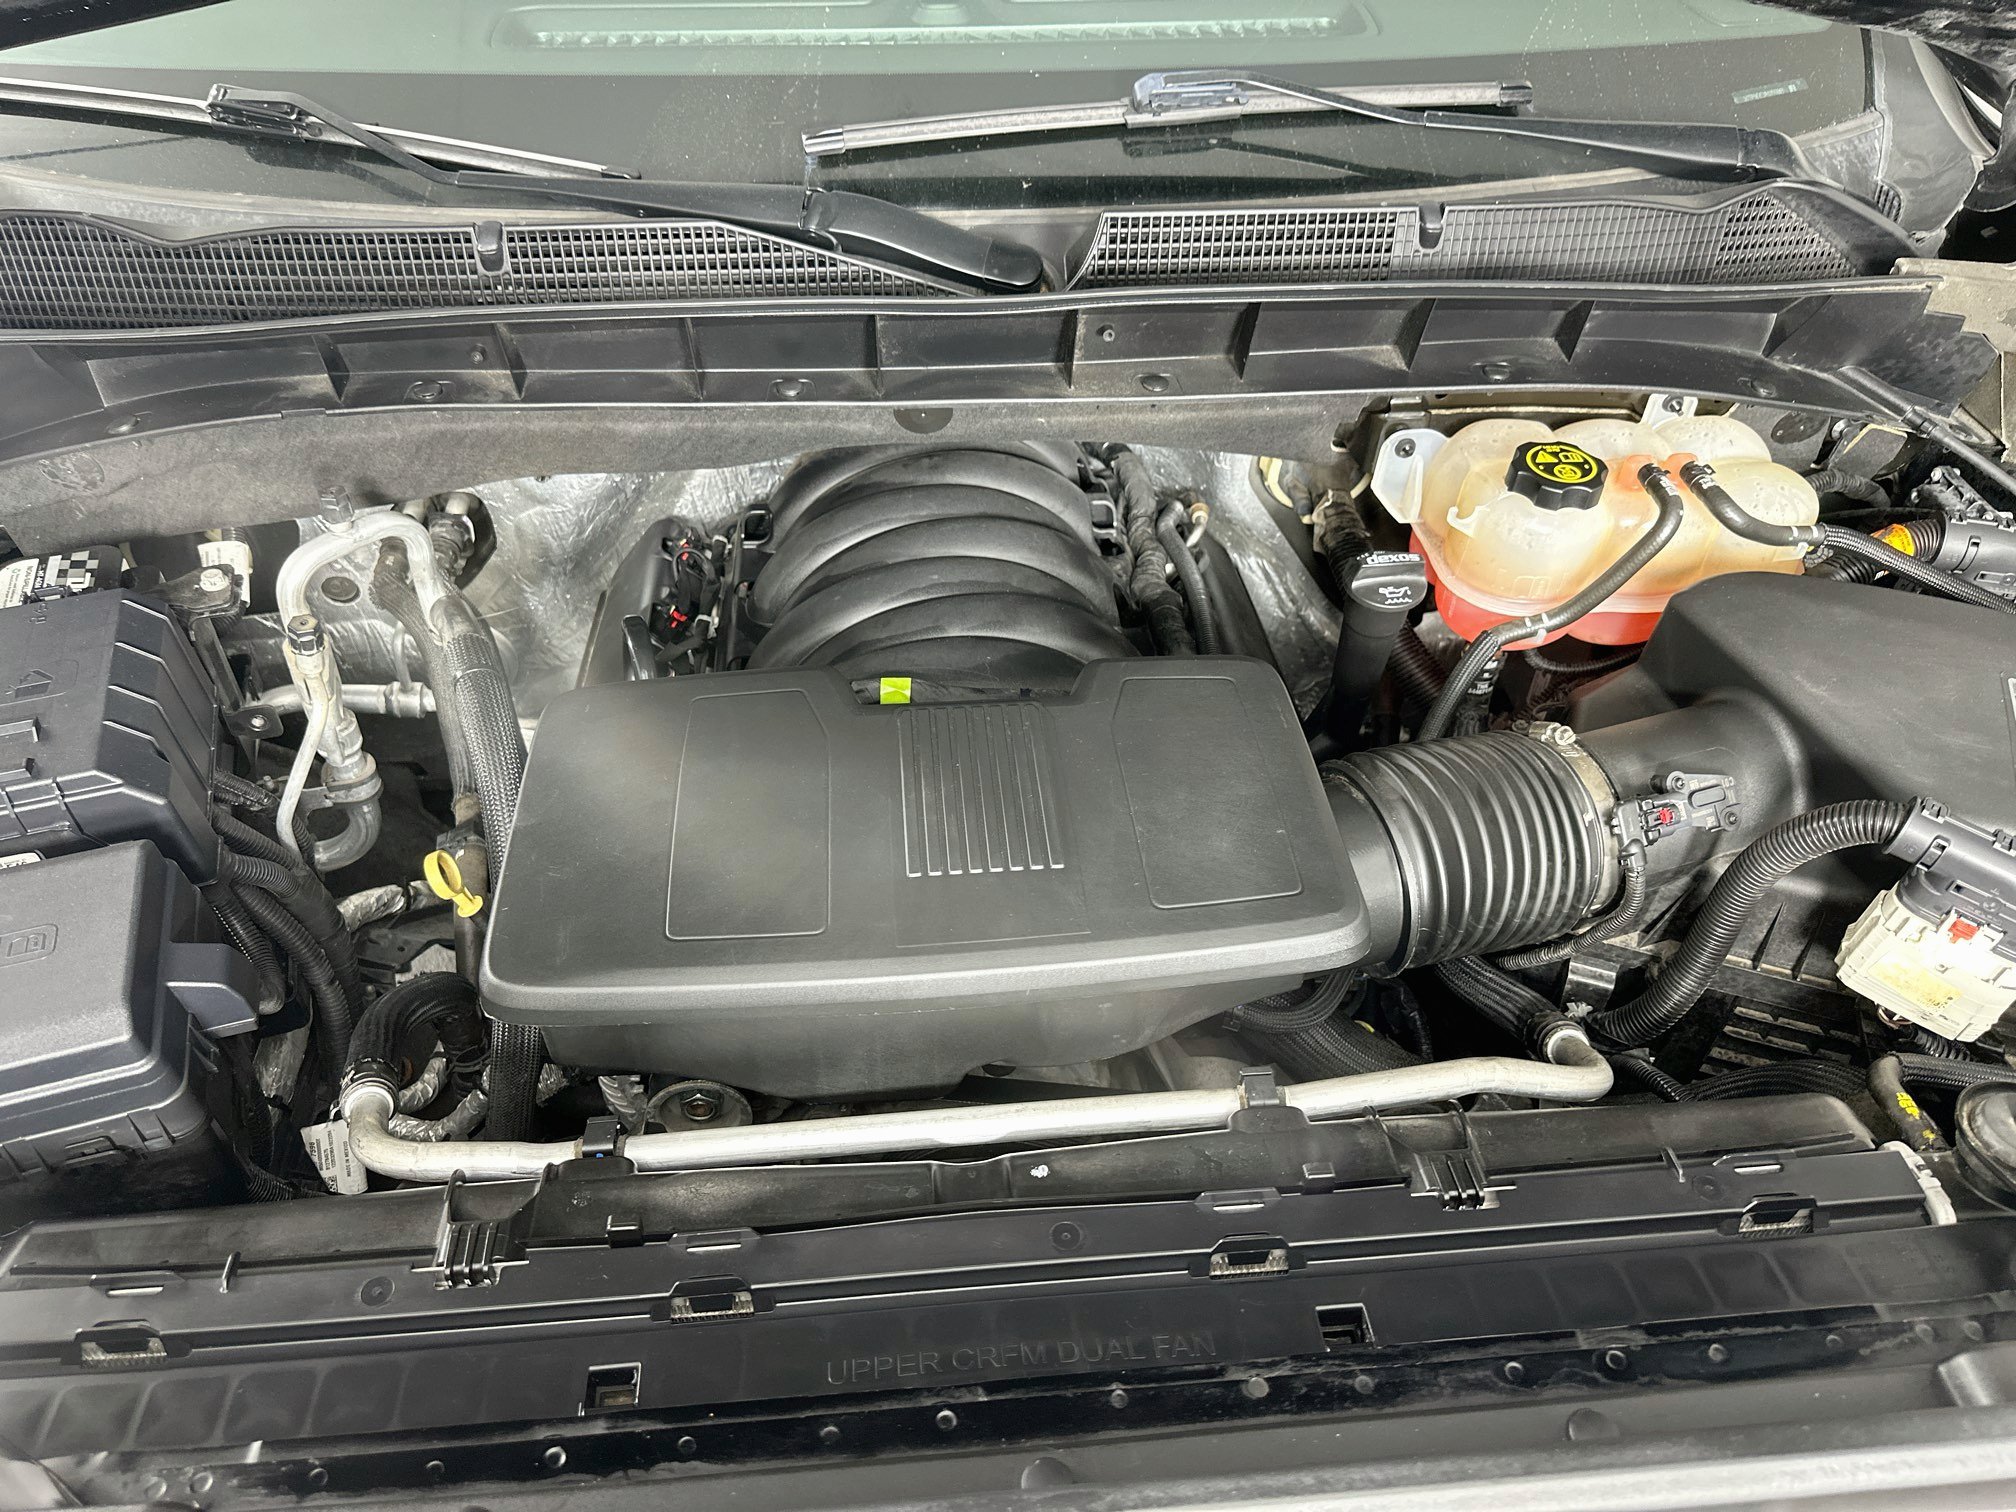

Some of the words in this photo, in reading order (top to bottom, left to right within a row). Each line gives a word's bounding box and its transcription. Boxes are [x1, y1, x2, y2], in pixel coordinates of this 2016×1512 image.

[1366, 554, 1420, 564] dexos
[827, 1351, 944, 1385] UPPER
[952, 1342, 1048, 1370] CRFM
[1056, 1336, 1147, 1363] DUAL
[1151, 1331, 1218, 1359] FAN
